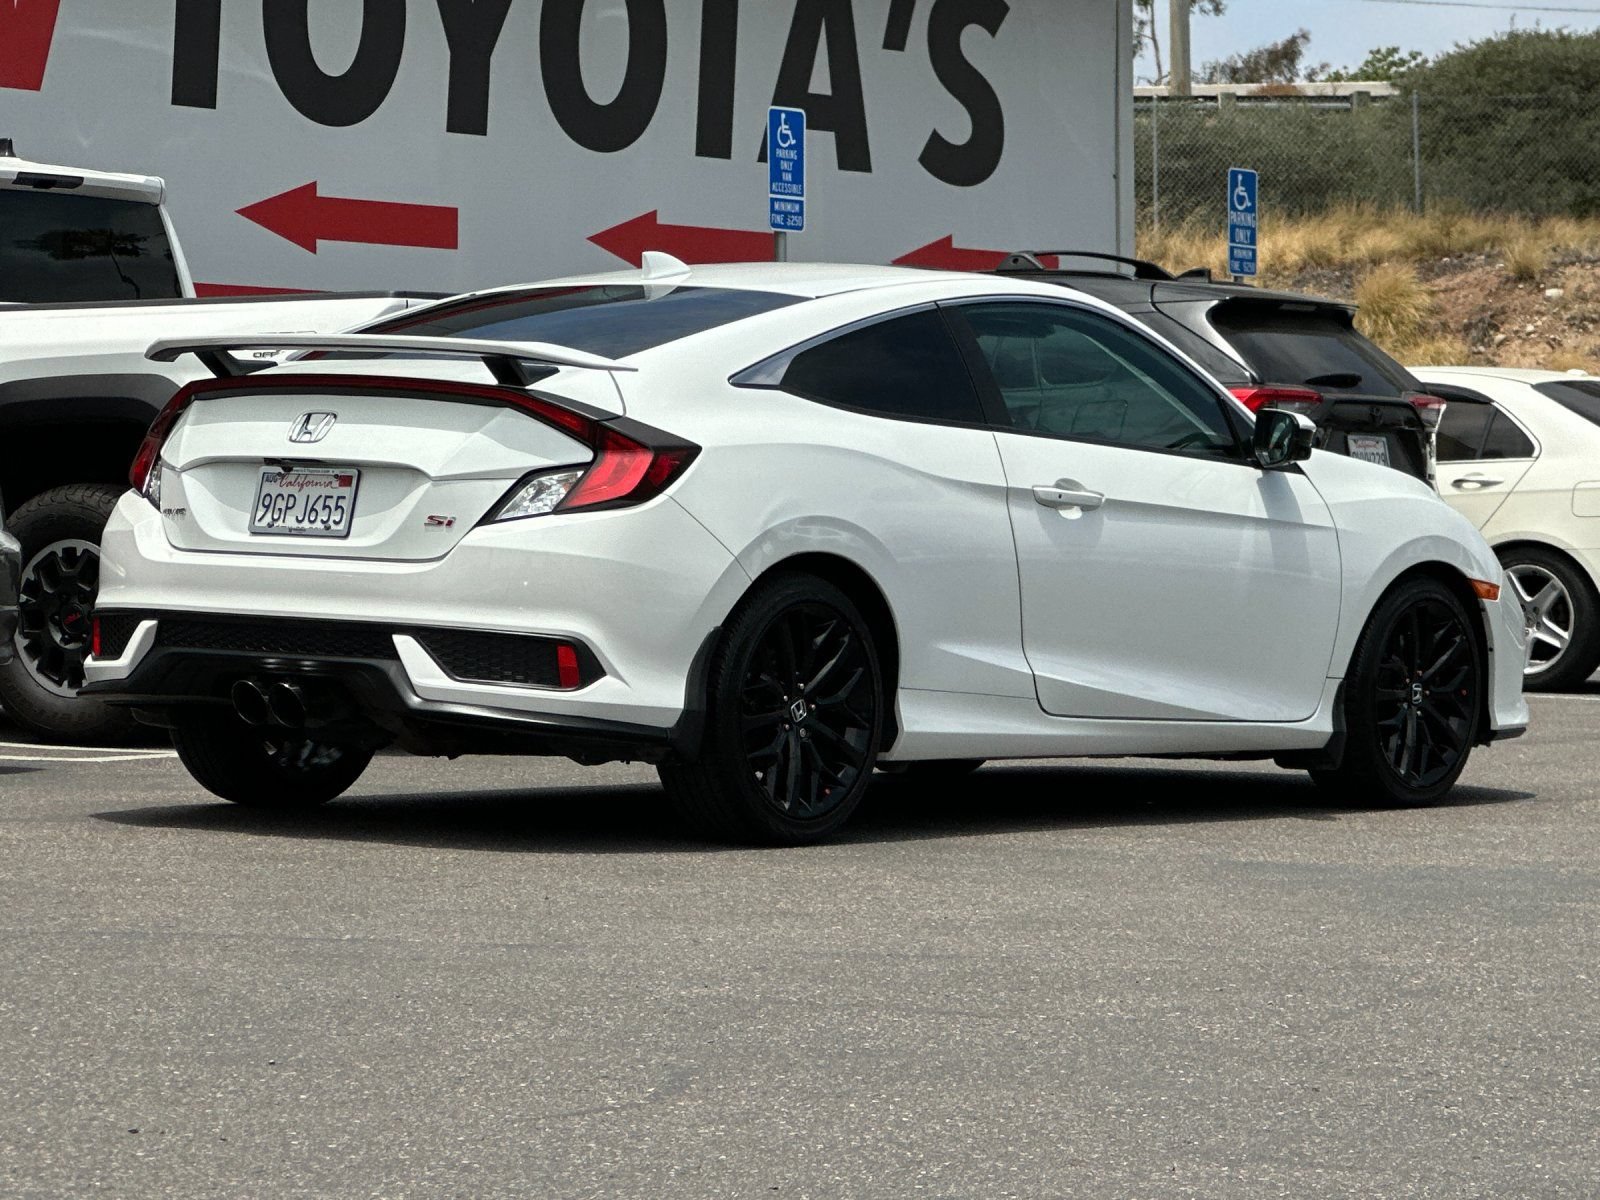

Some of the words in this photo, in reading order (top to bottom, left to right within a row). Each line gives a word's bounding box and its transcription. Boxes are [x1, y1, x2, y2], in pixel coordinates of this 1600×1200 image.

[775, 148, 798, 160] PARKING
[780, 160, 793, 171] ONLY
[782, 172, 792, 181] VAN
[772, 182, 802, 194] ACCESSIBLE
[774, 200, 800, 213] MINIMUM
[771, 213, 785, 225] FINE
[786, 215, 802, 227] $250
[1230, 211, 1256, 228] PARKING
[1235, 228, 1251, 243] ONLY
[279, 473, 337, 492] California
[257, 493, 347, 525] 9GPJ655
